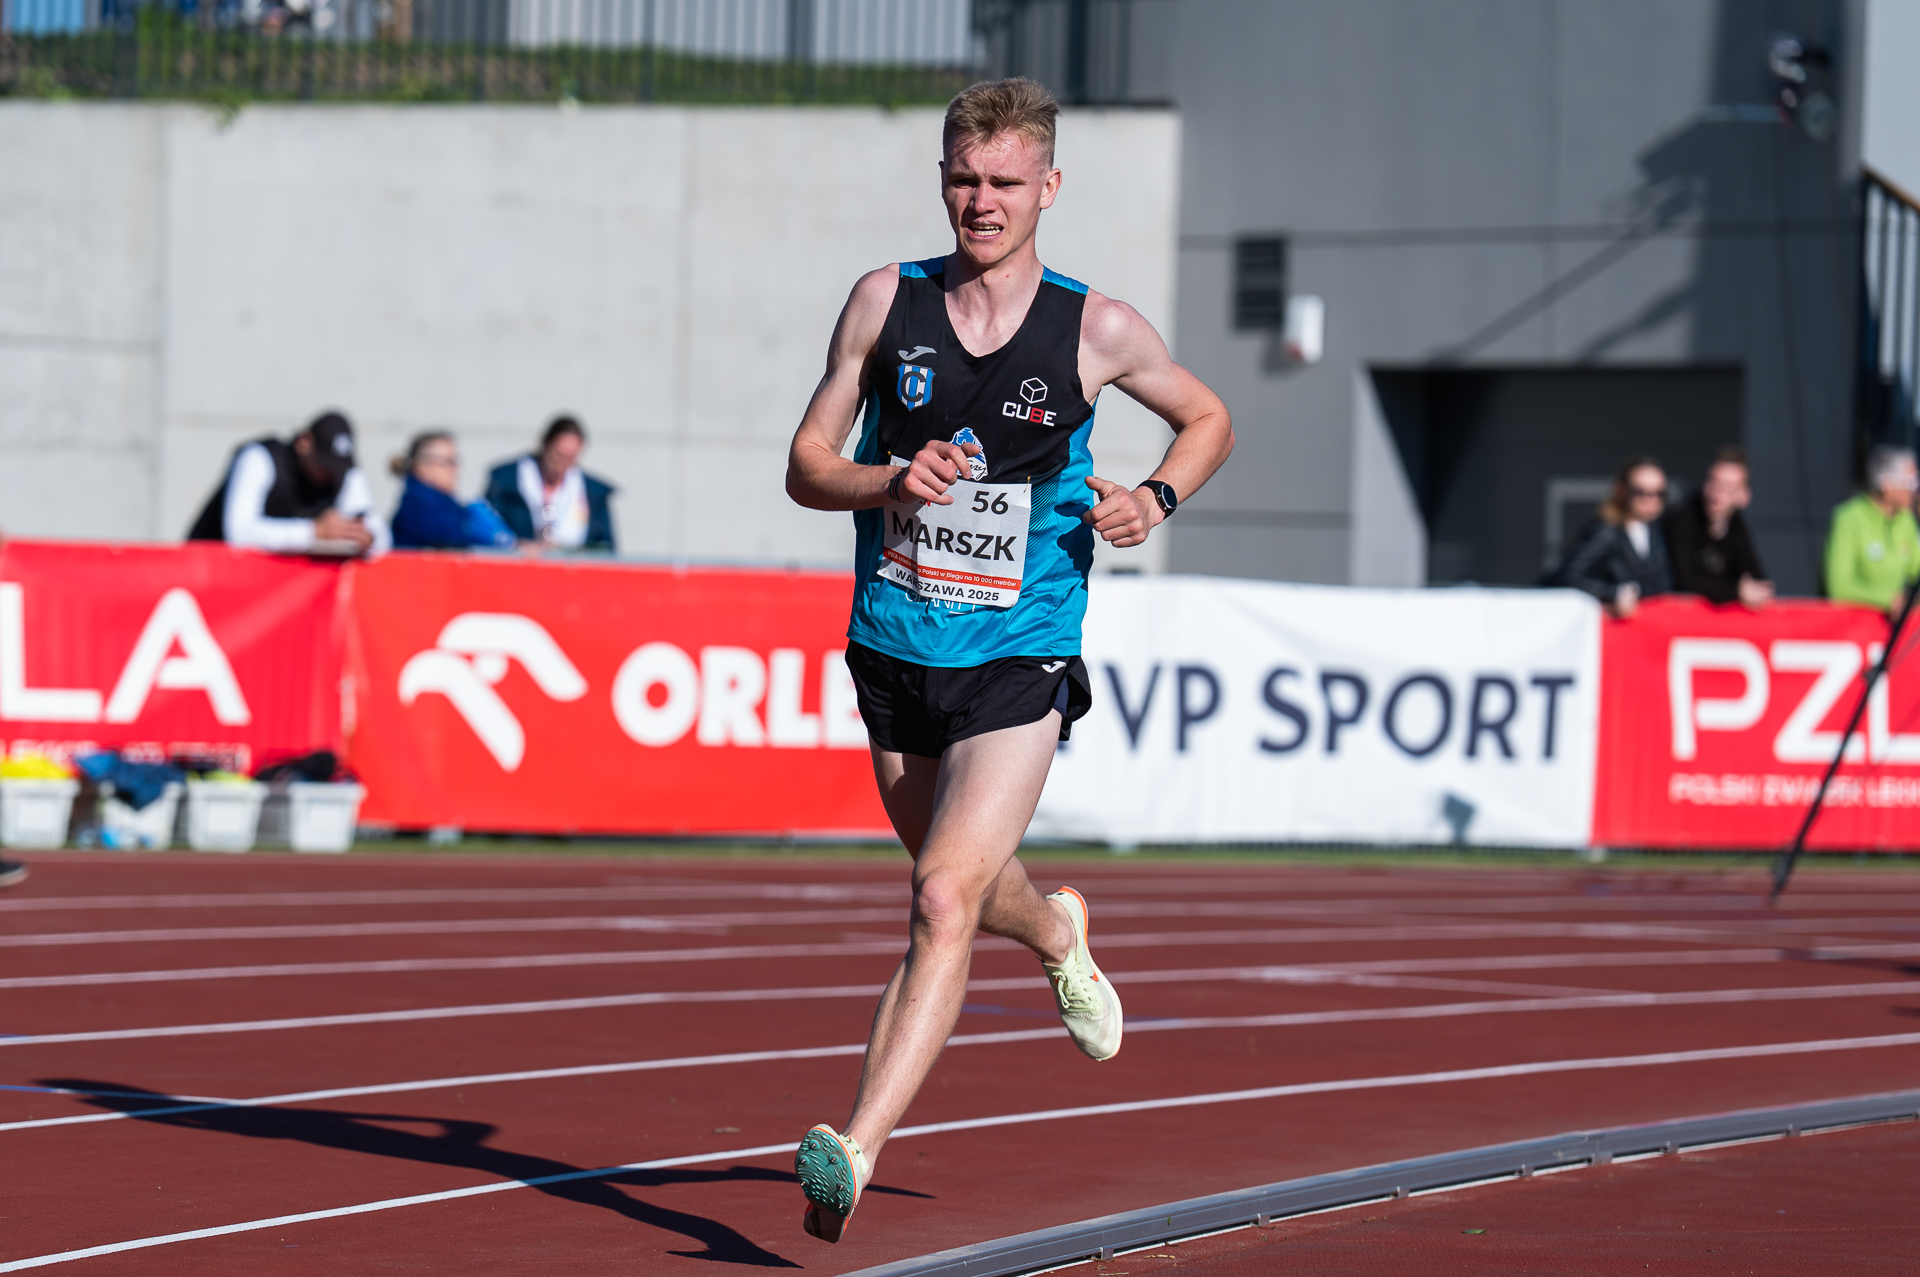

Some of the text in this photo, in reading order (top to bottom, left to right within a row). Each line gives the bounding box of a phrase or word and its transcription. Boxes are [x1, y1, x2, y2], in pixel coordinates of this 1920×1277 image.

[901, 371, 926, 402] C
[1002, 401, 1057, 427] CUBE
[971, 490, 1009, 515] 56
[893, 511, 1017, 562] MARSZK
[895, 568, 1000, 601] WARSZAWA 2025
[922, 568, 939, 577] Polski
[946, 571, 963, 580] Biegu
[993, 579, 1017, 587] metrów
[611, 641, 870, 750] ORLE
[1060, 661, 1578, 762] VP SPORT
